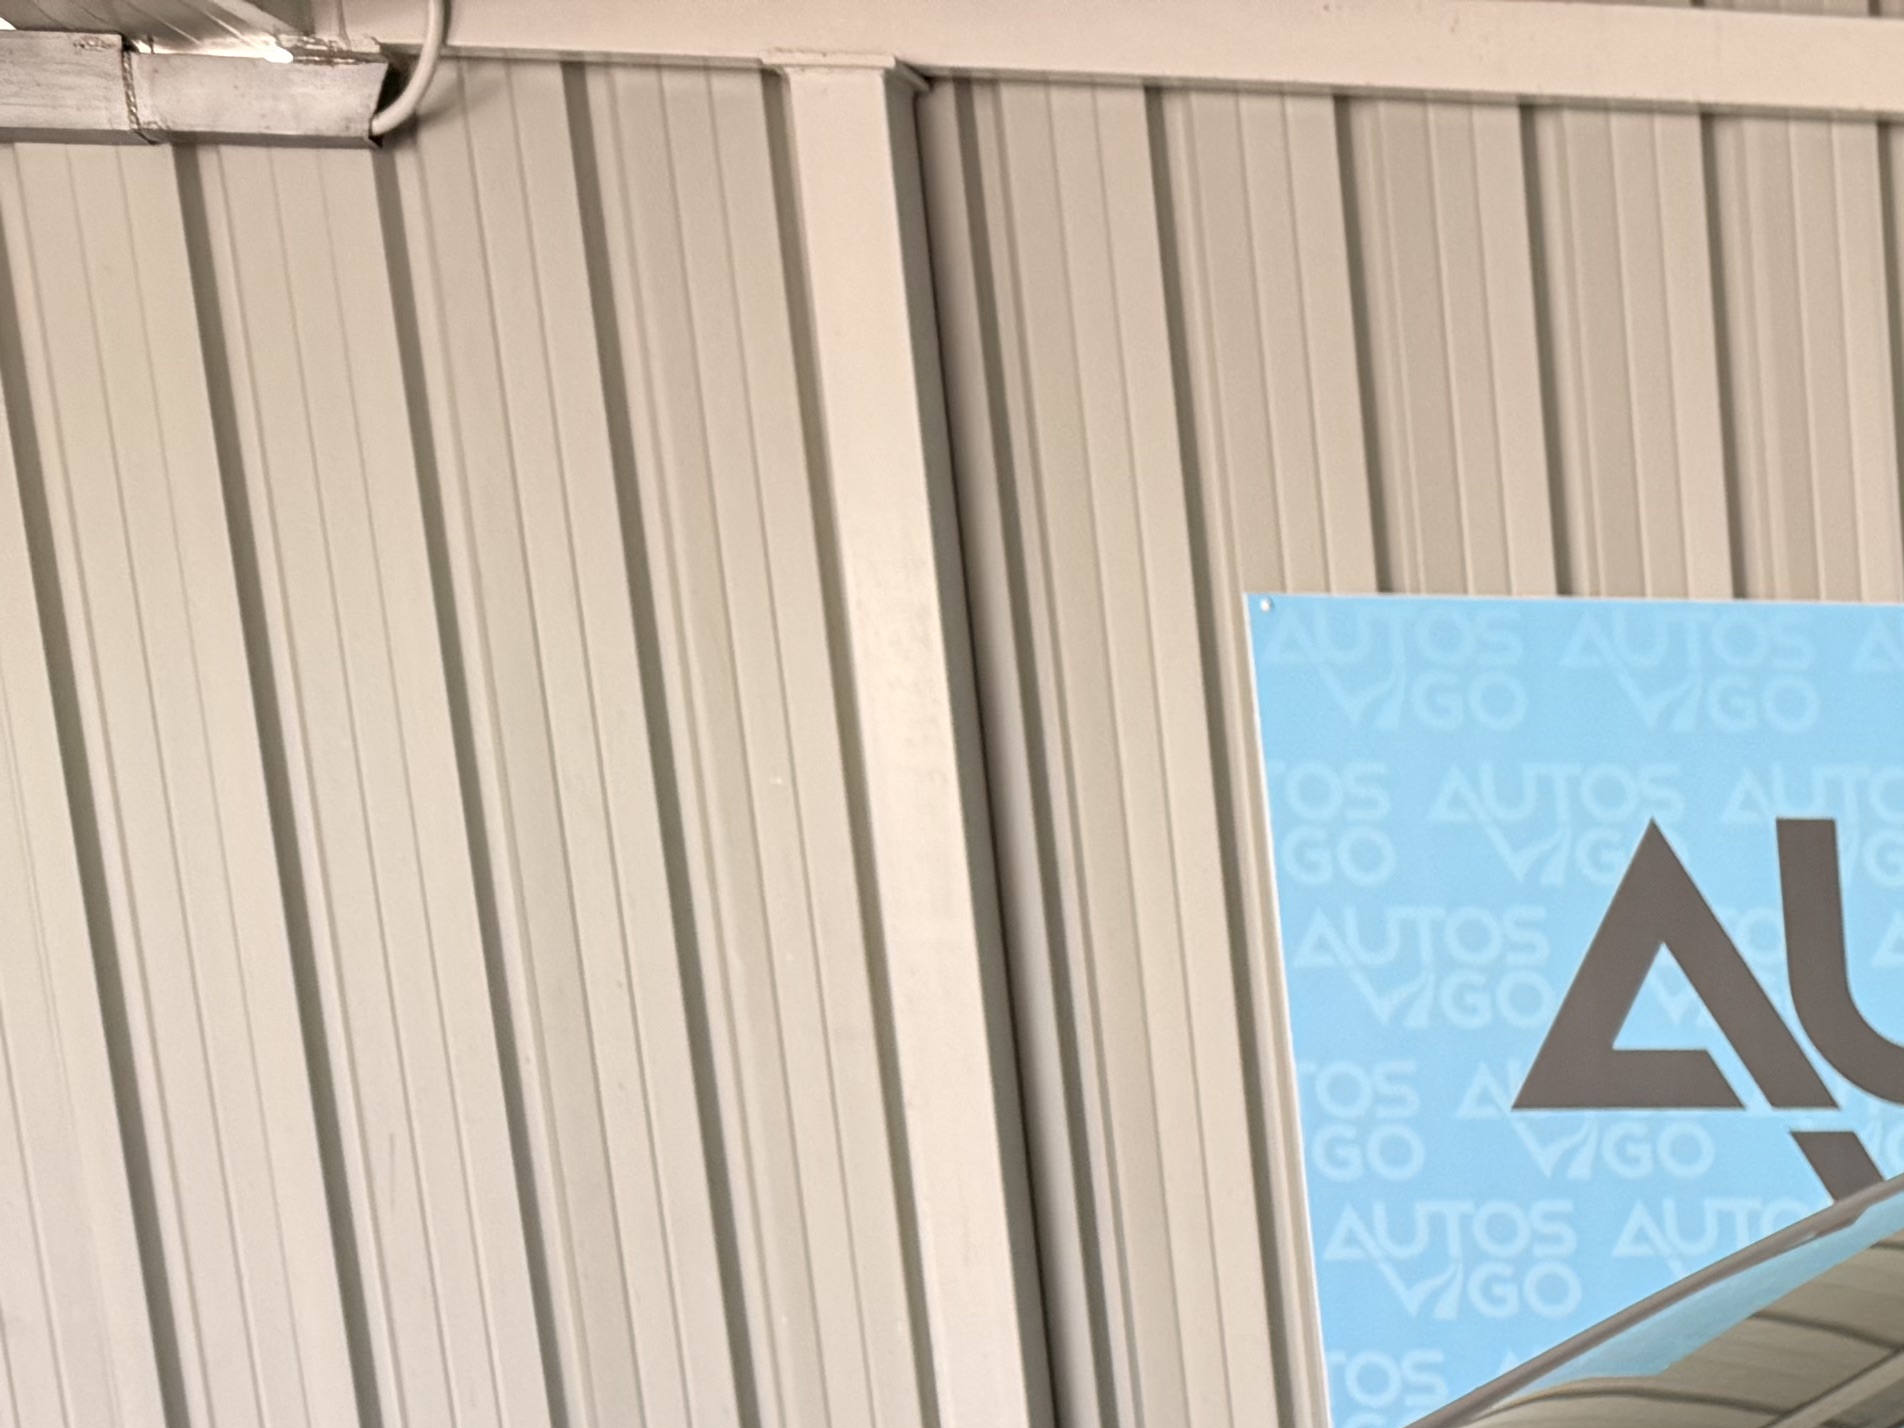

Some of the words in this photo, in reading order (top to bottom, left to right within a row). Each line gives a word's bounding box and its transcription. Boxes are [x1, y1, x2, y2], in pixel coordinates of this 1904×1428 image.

[1262, 606, 1524, 667] AUTOS
[1559, 608, 1816, 670] AUTOS
[1294, 906, 1550, 968] AUTOS
[1324, 1198, 1577, 1260] AUTOS
